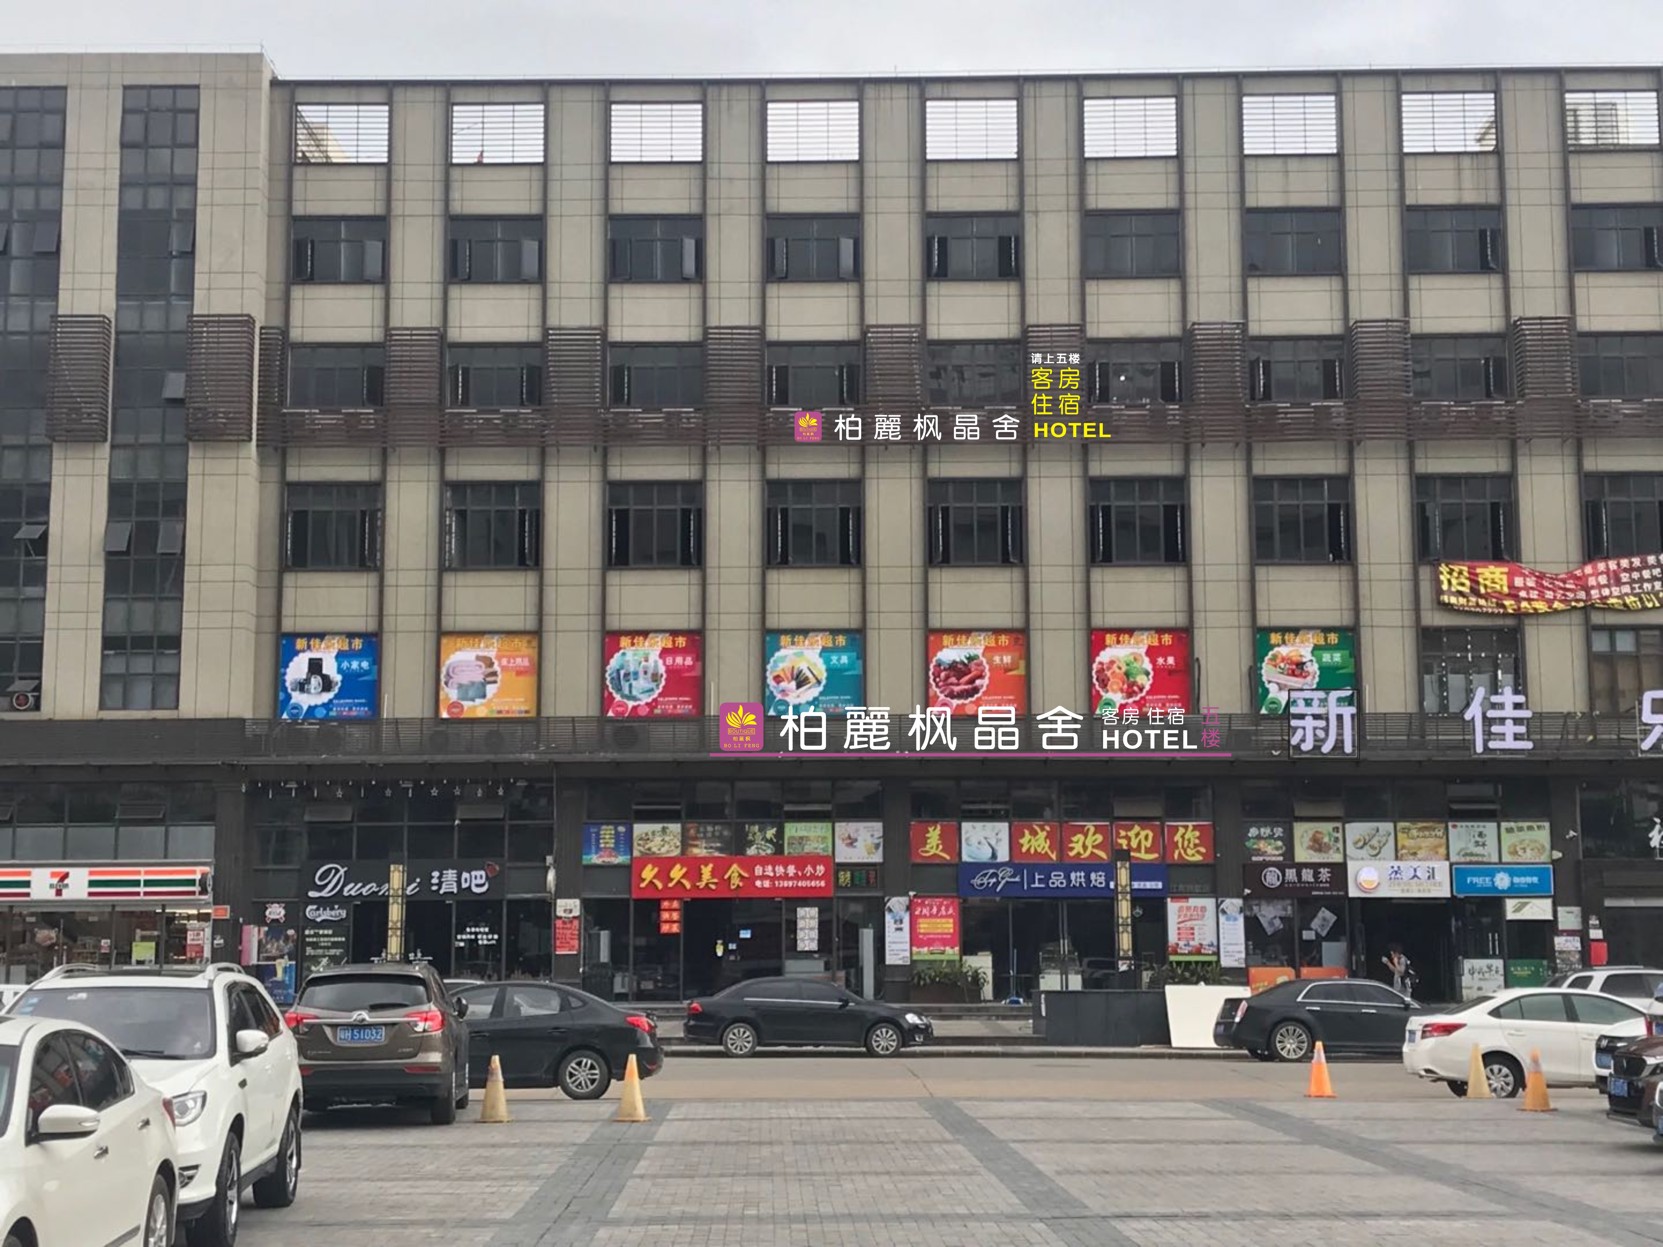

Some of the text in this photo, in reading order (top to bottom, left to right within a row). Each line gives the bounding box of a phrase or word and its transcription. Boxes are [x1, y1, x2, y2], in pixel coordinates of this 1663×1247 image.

[1439, 563, 1509, 594] 招商
[341, 660, 370, 670] 小家电
[666, 656, 693, 666] 日用品
[830, 655, 848, 665] 文具
[1156, 656, 1176, 666] 水果
[918, 825, 950, 860] 美
[638, 863, 750, 890] 久久美食
[754, 864, 826, 877] 自选快餐、小炒
[431, 869, 490, 894] 清吧
[1031, 871, 1106, 888] 上品烘焙
[1467, 876, 1492, 884] FREE
